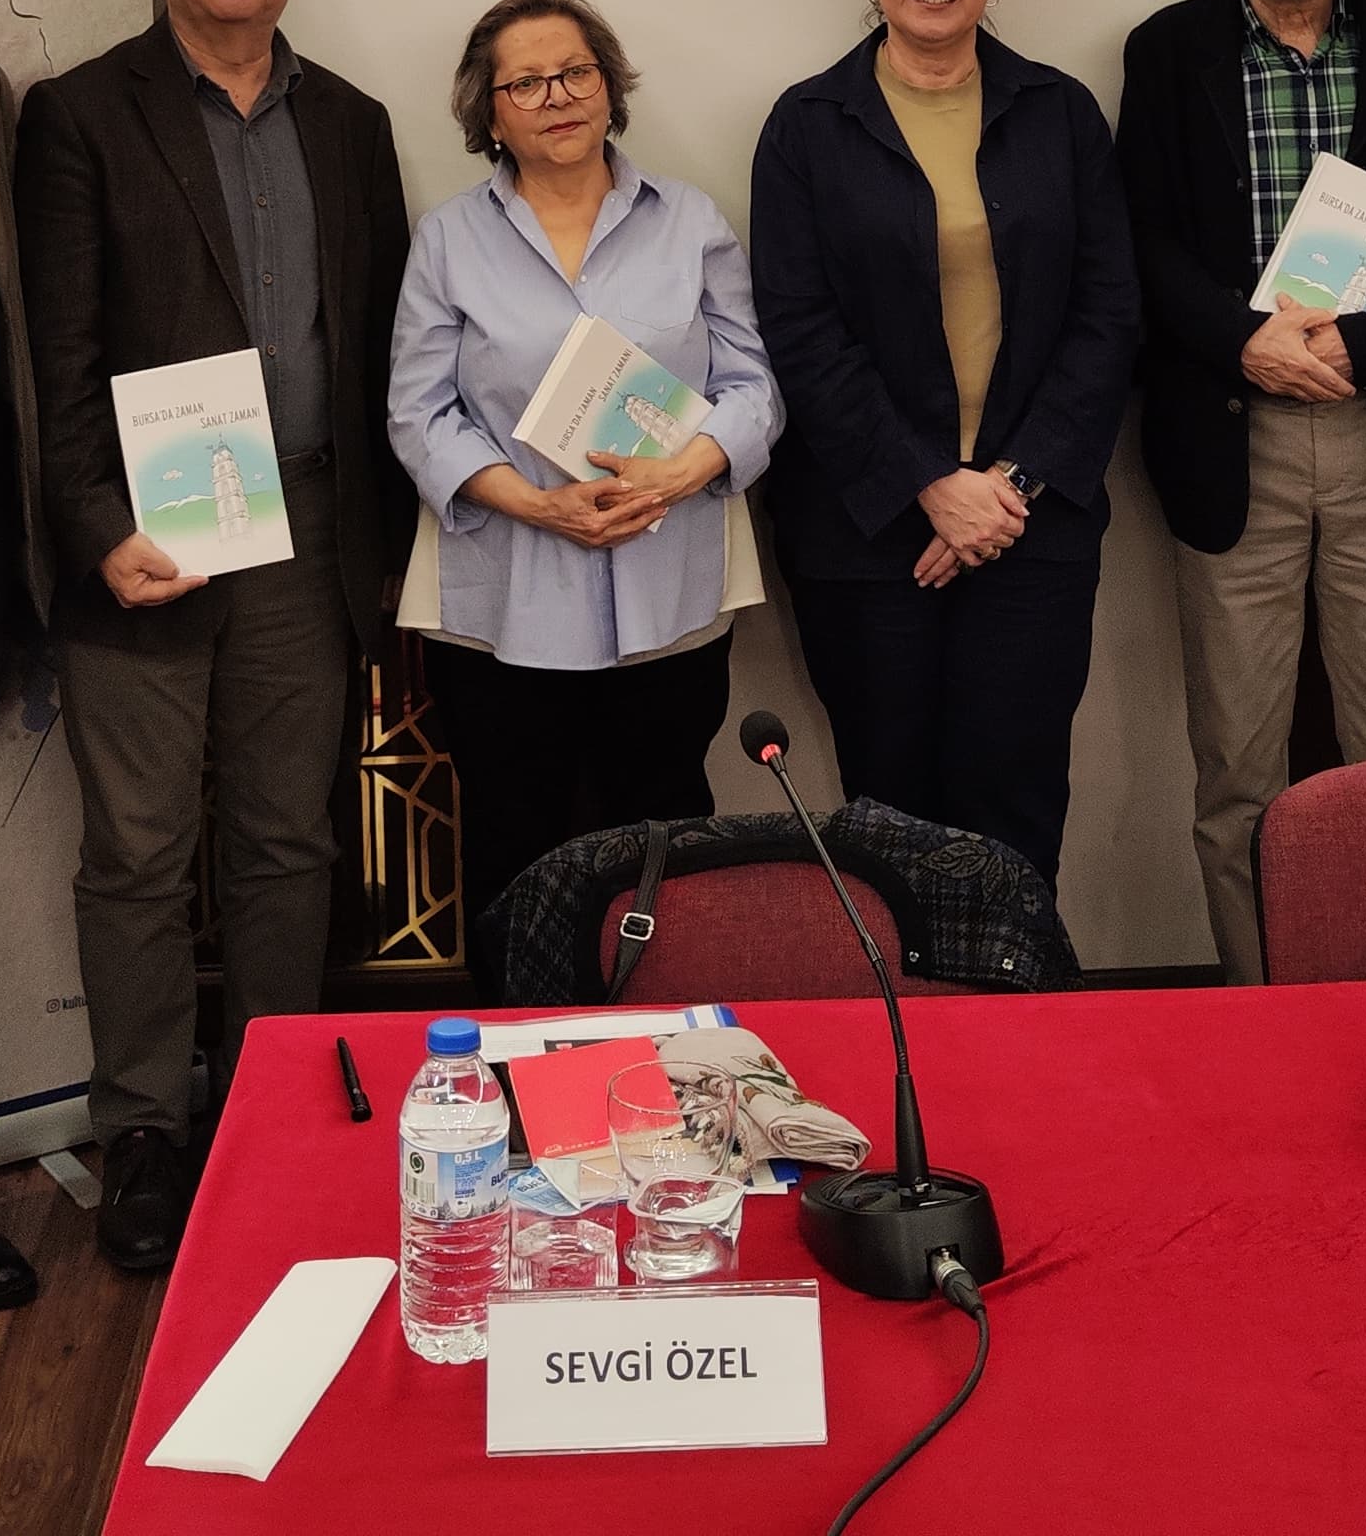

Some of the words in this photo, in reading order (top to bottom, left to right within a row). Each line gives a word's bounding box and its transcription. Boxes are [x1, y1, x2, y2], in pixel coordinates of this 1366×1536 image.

[578, 386, 598, 415] ZAMAN
[598, 376, 615, 402] SANAT
[176, 402, 205, 419] ZAMAN
[200, 413, 227, 430] SANAT
[544, 1340, 654, 1384] SEVGİ
[665, 1340, 758, 1380] ÖZEL
